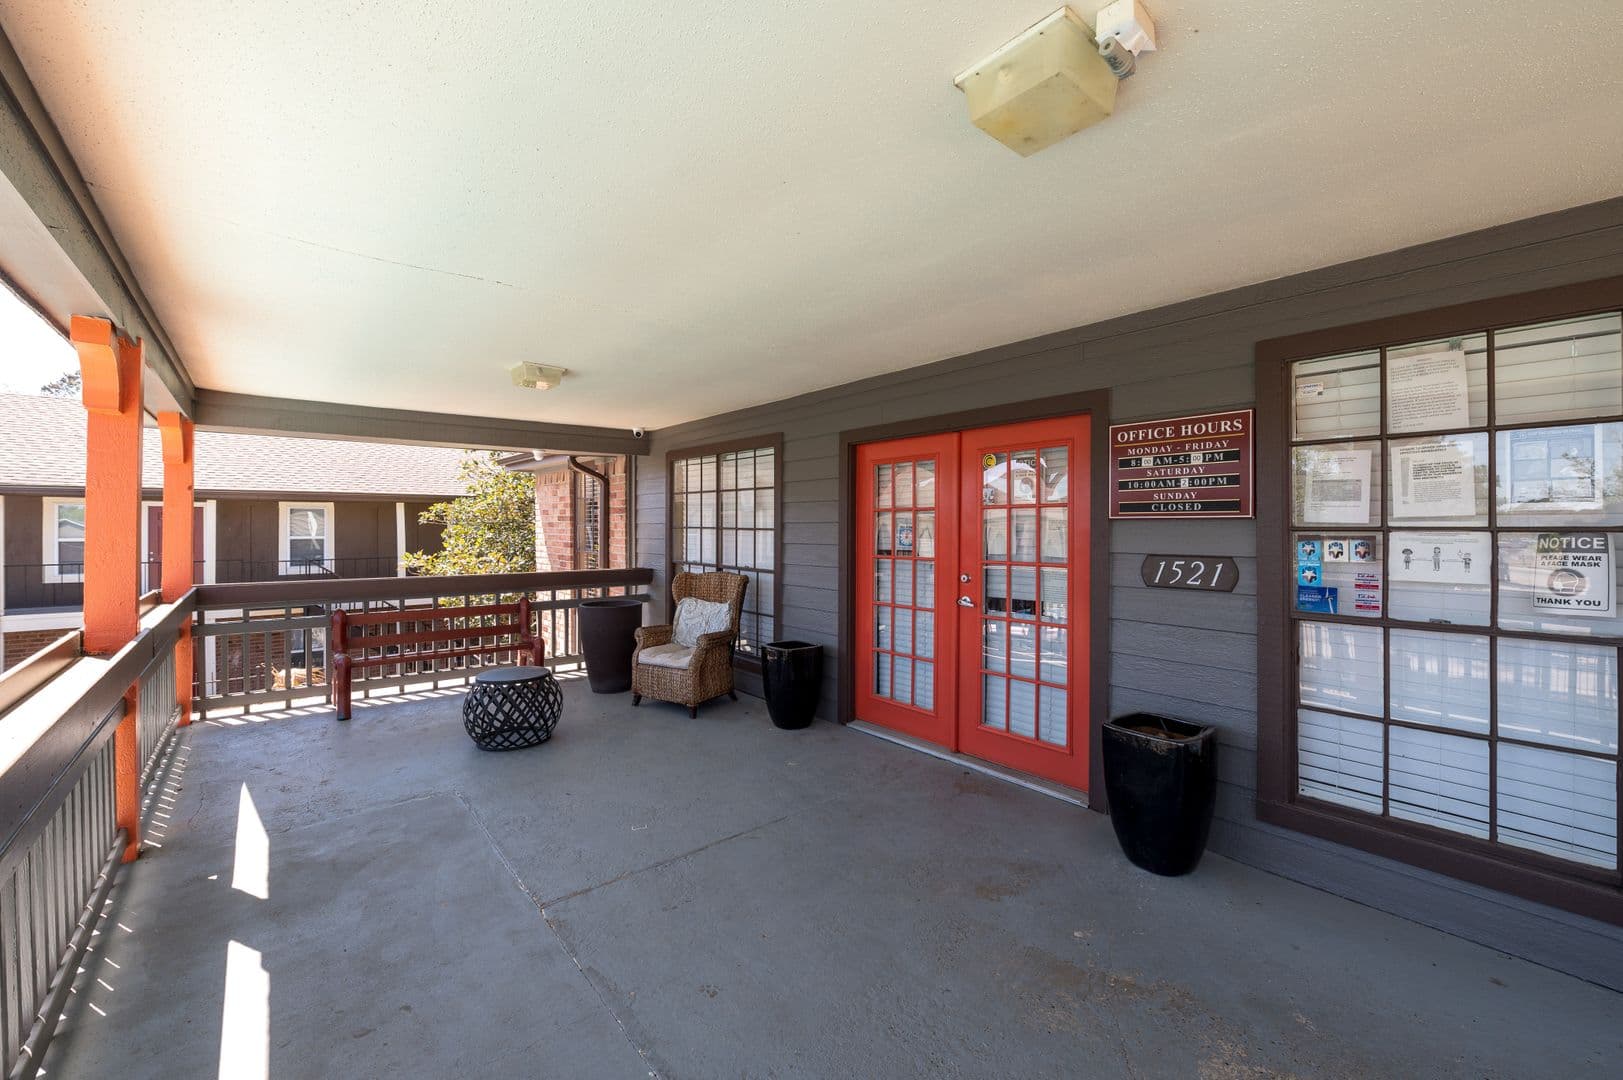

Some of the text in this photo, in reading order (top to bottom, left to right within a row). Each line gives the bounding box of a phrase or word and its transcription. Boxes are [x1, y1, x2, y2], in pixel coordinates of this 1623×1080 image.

[1117, 419, 1243, 443] OFFICE HOURS
[1127, 445, 1173, 456] MONDAY
[1185, 440, 1229, 451] FRIDAY
[1146, 466, 1205, 477] SATURDAY
[1153, 491, 1197, 501] SUNDAY
[1151, 503, 1202, 511] CLOSED
[1539, 537, 1605, 549] NOTICE
[1154, 561, 1223, 587] 1521
[1536, 597, 1601, 607] THANK YOU
